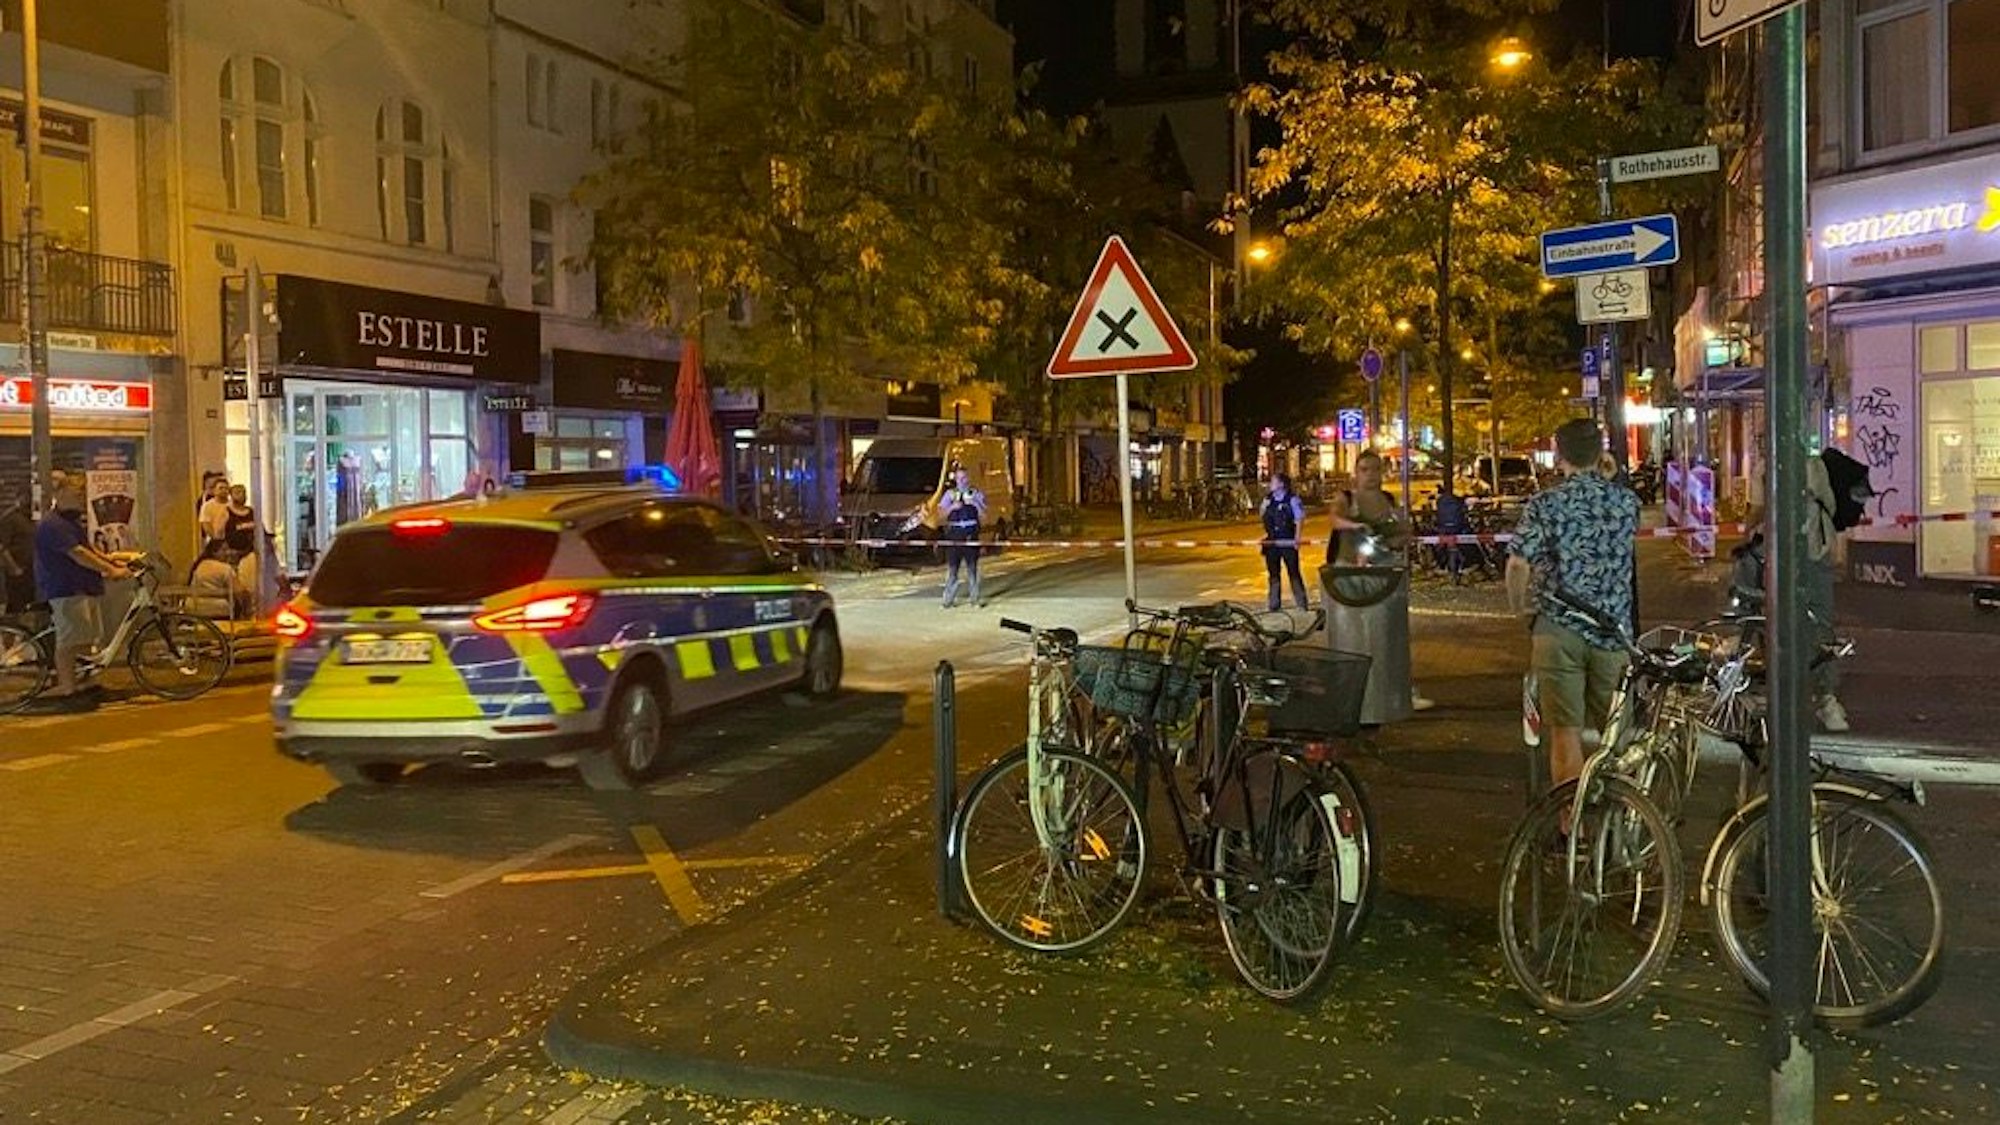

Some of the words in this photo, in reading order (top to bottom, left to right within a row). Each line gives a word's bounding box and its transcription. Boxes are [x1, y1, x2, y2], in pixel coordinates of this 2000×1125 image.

[1618, 153, 1713, 176] Rothehausstr.
[1821, 202, 1968, 249] senzera
[1550, 239, 1636, 259] Einbahnstraße
[357, 310, 490, 358] ESTELLE
[49, 384, 127, 405] nited
